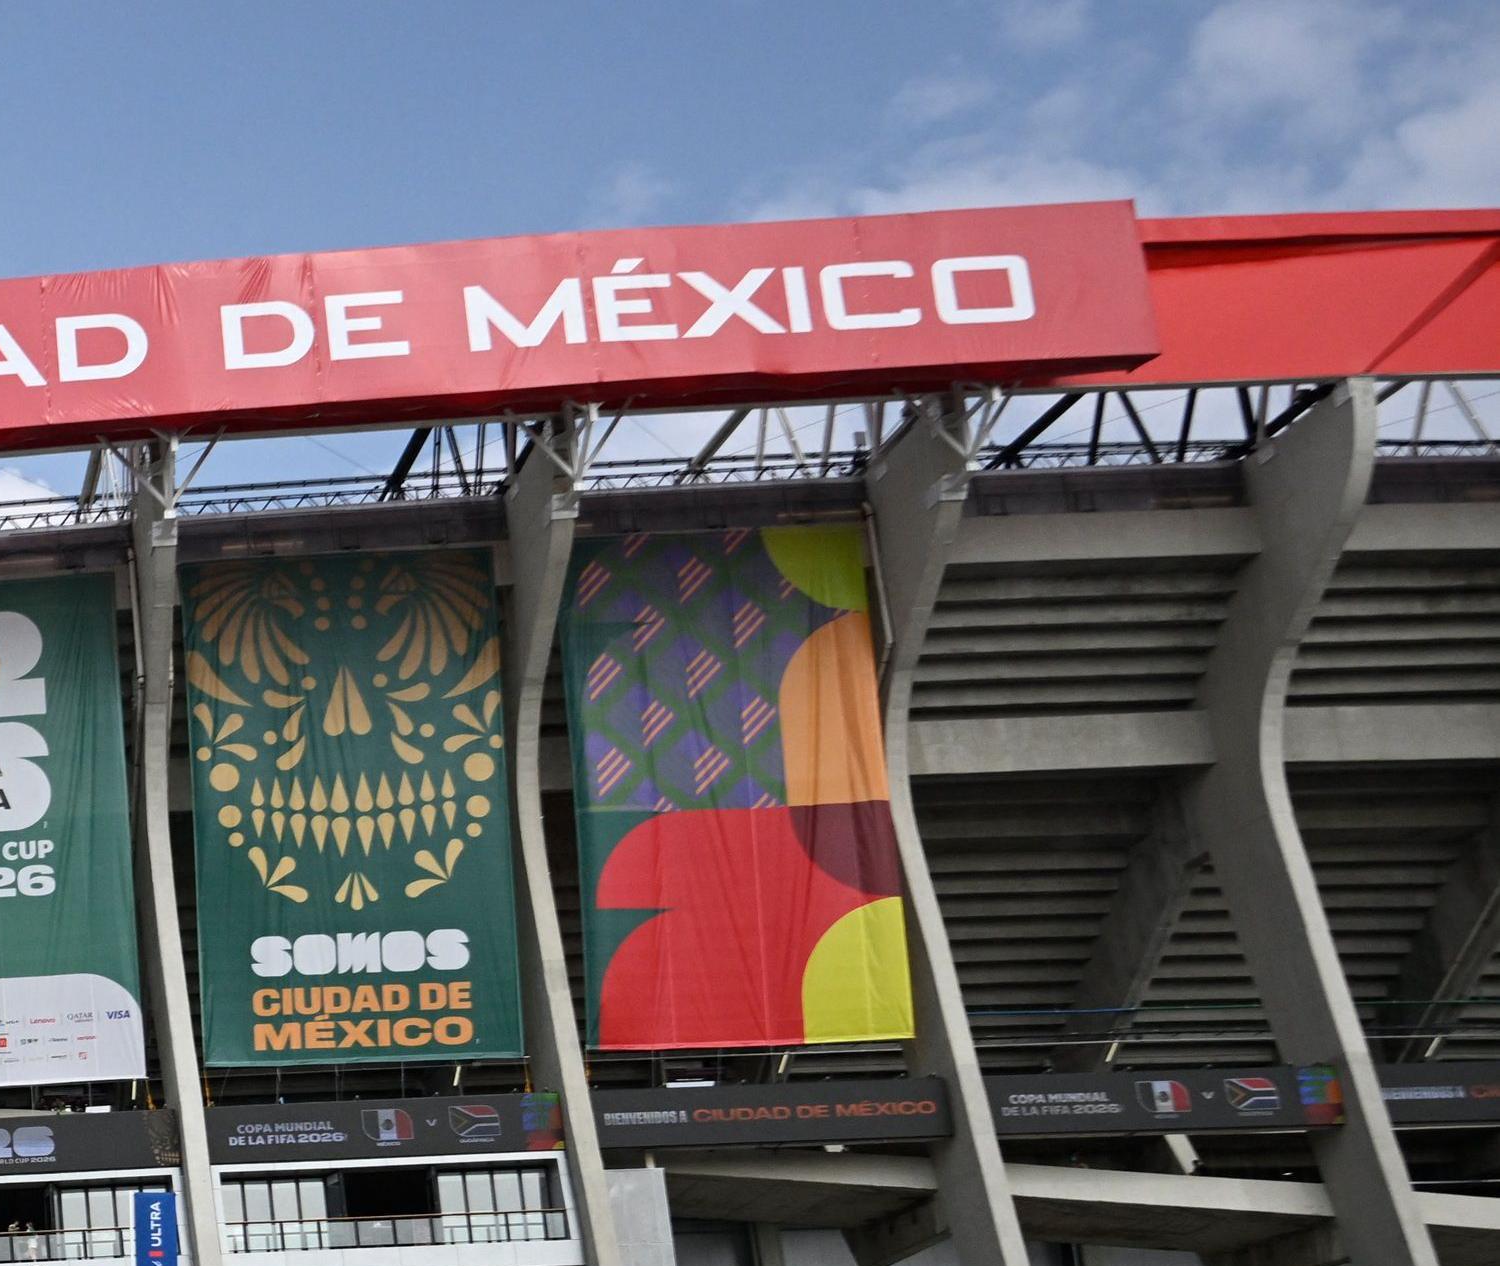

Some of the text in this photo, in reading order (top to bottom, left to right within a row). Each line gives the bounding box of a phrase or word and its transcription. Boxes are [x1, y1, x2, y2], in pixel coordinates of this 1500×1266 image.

[223, 289, 411, 371] DE
[463, 253, 1037, 355] MÉXICO
[2, 840, 54, 859] CUP
[251, 928, 470, 977] SOMOS
[252, 982, 472, 1016] CIUDAD DE
[106, 1010, 130, 1020] VISA
[253, 1014, 474, 1051] MÉXICO
[1009, 1094, 1046, 1104] COPA
[1041, 1105, 1071, 1115] FIFA
[603, 1100, 936, 1126] BIENVENIDOS CIUDAD DE MÉXICO
[237, 1120, 334, 1133] COPA MUNDIAL
[229, 1132, 344, 1146] DE LA FIFA 2026
[151, 1202, 162, 1247] ULTRA
